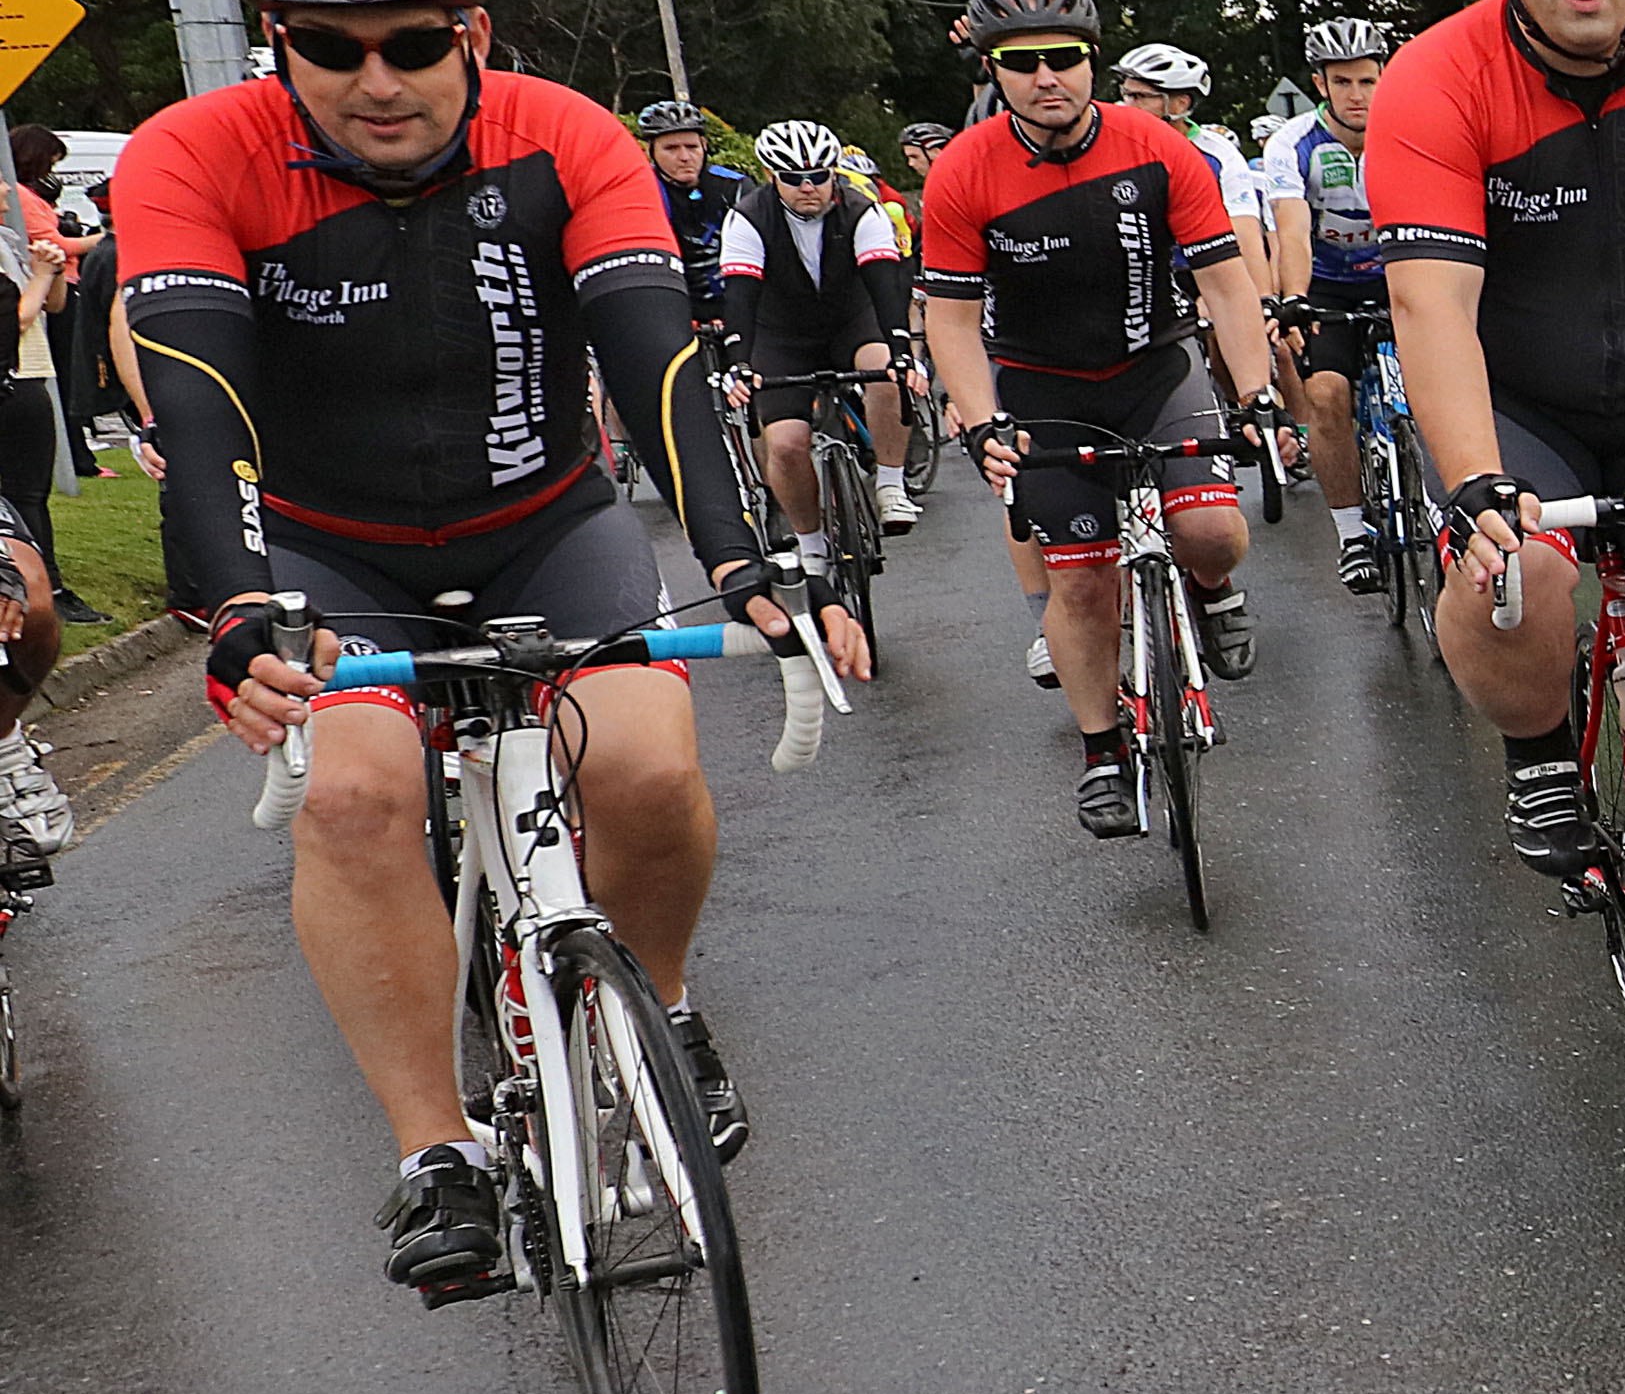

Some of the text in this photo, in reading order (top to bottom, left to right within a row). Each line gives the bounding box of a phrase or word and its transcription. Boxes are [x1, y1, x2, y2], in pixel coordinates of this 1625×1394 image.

[1488, 177, 1513, 191] The
[1487, 184, 1588, 214] Village Inn
[989, 235, 1071, 256] Village Inn
[1325, 228, 1370, 243] 211
[338, 280, 391, 304] Inn
[1116, 211, 1150, 354] Kilworth
[471, 241, 547, 488] Kilworth
